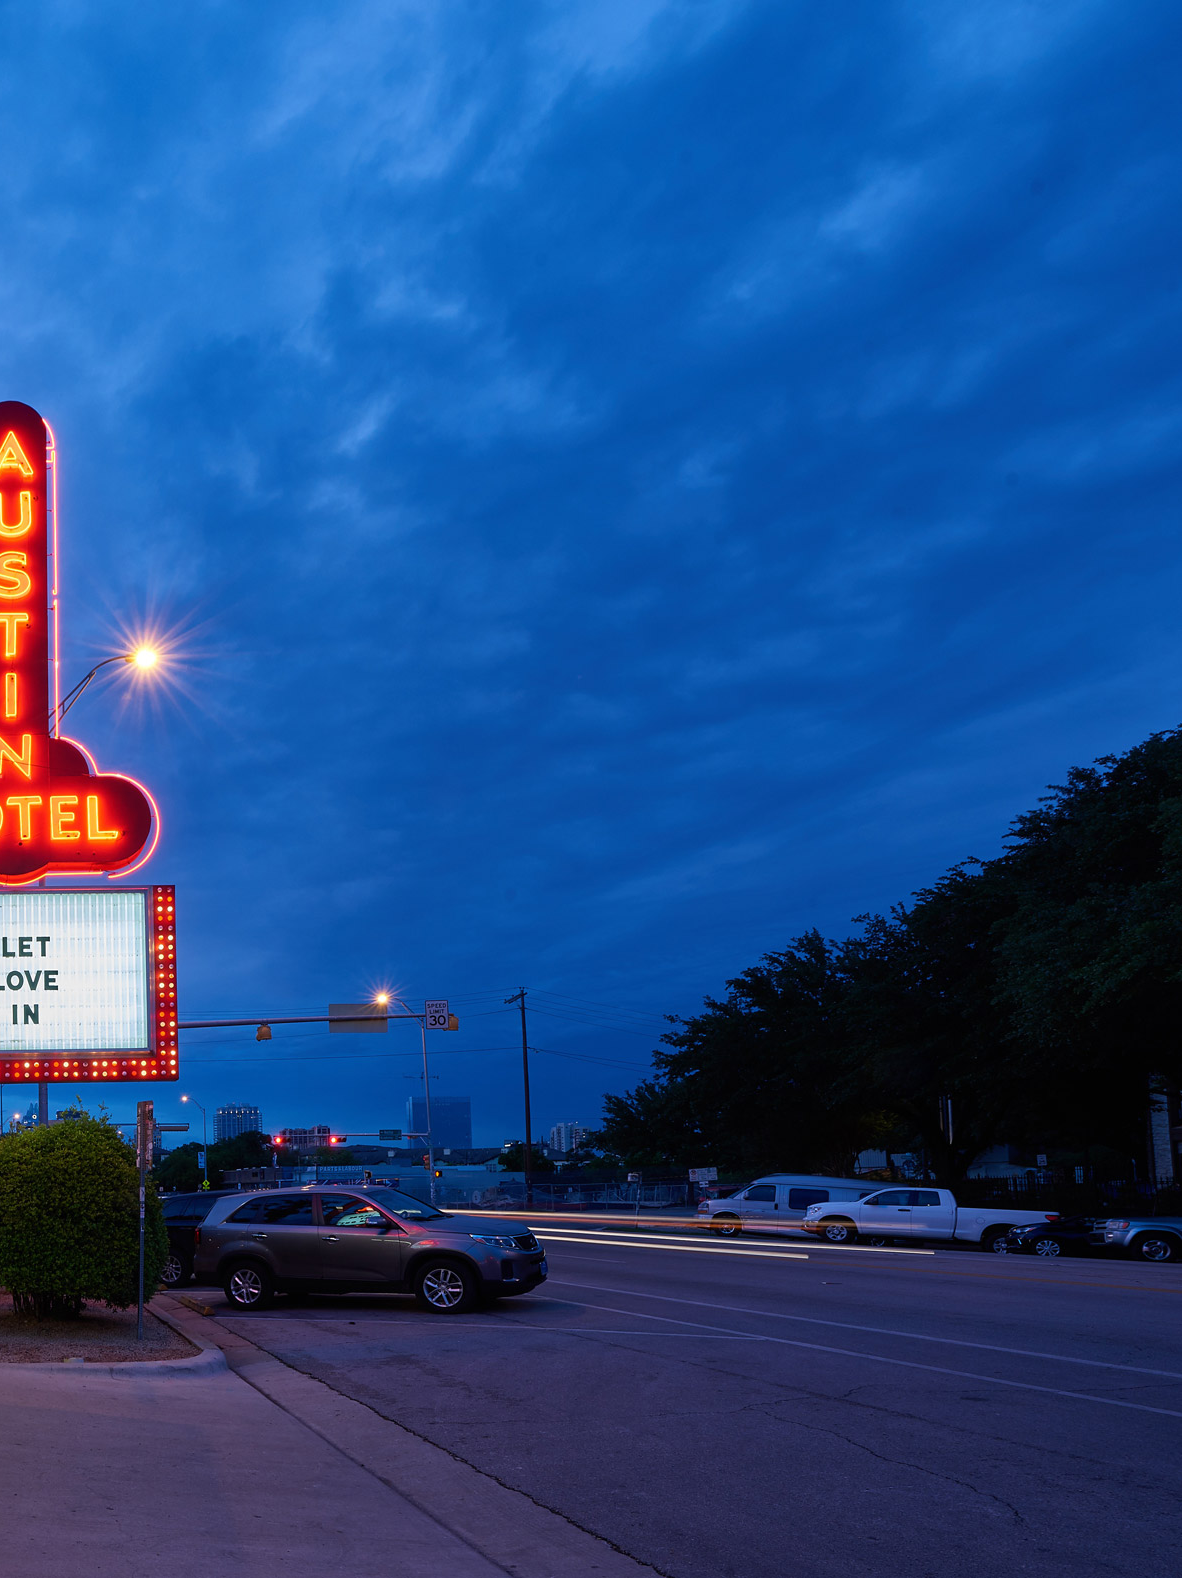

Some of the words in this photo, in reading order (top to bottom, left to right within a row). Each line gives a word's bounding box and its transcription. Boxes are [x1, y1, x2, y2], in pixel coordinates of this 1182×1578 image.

[2, 937, 50, 958] LET
[13, 1004, 39, 1025] IN
[429, 1015, 446, 1026] 30
